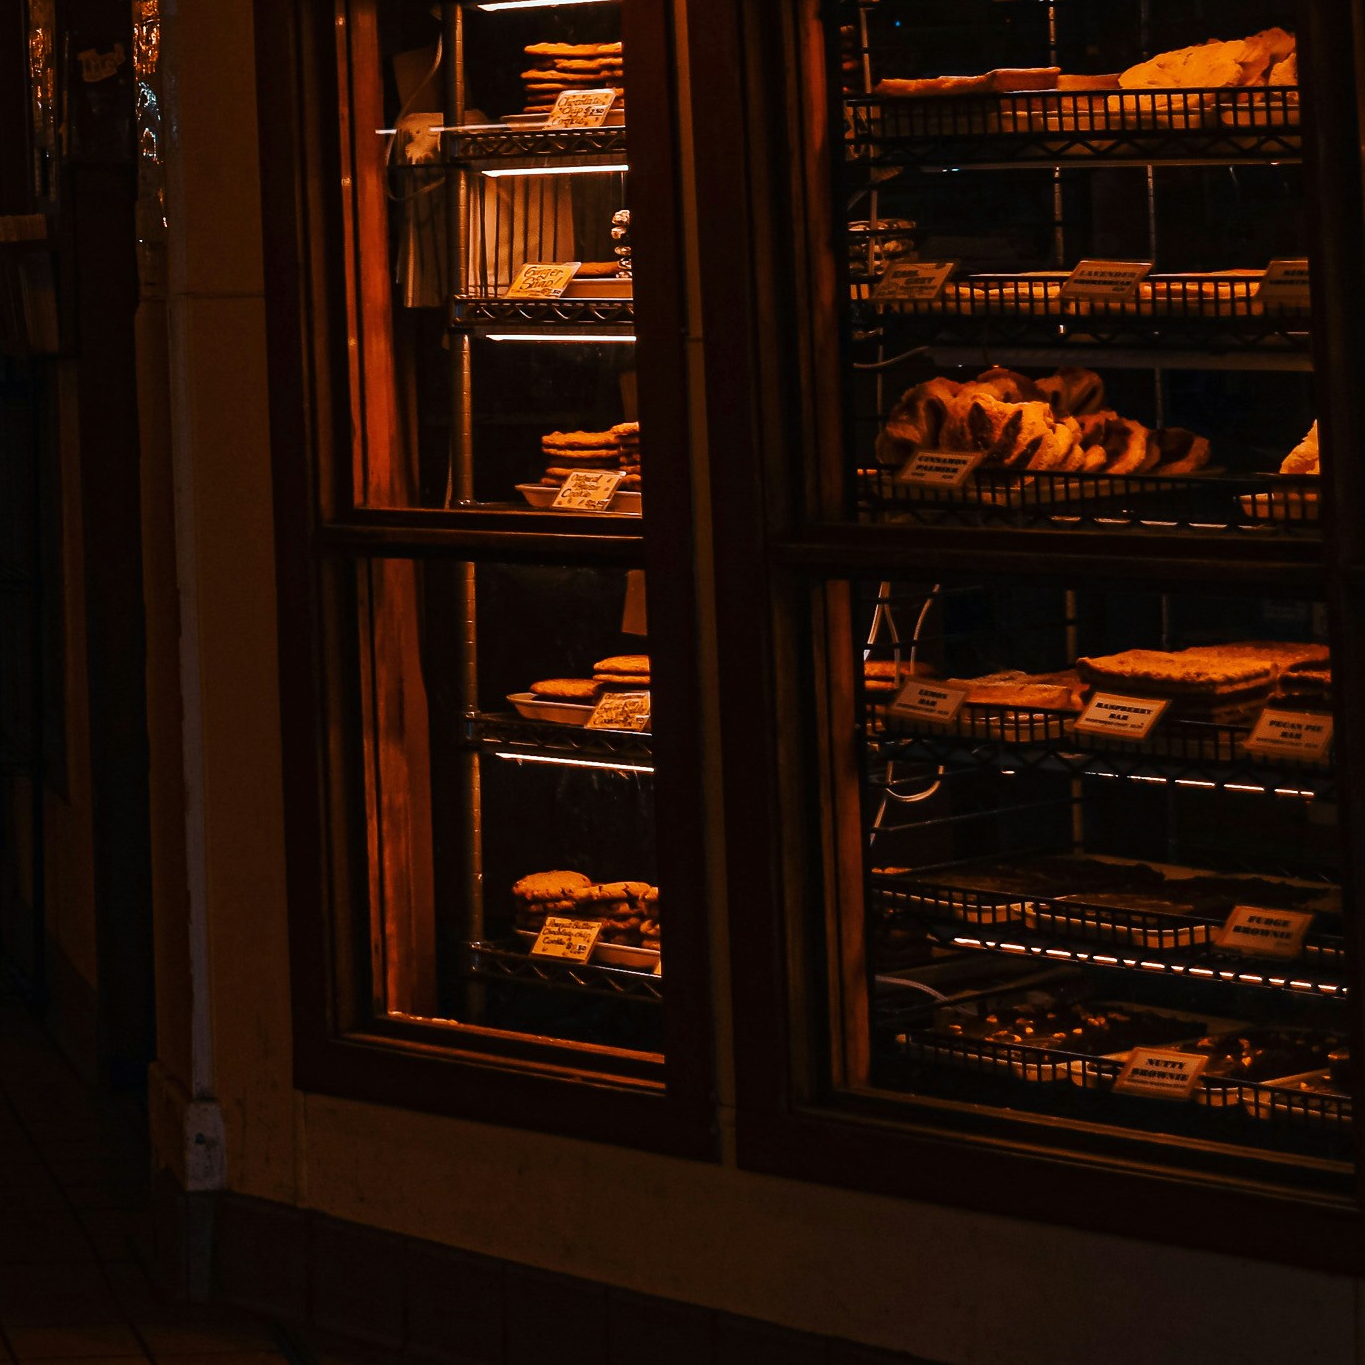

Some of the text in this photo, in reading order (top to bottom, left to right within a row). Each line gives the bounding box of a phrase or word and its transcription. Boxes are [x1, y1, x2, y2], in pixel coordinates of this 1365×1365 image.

[918, 689, 948, 700] LEMON
[918, 698, 937, 706] BAR
[1095, 702, 1153, 714] RASPBERRY
[1269, 719, 1324, 732] PECAN PIE
[1280, 731, 1302, 739] BAR
[1248, 915, 1292, 927] FUDGE
[1233, 925, 1294, 939] BROWNIE
[1146, 1058, 1185, 1070] NUTTY
[1131, 1067, 1189, 1082] BROWNIE
